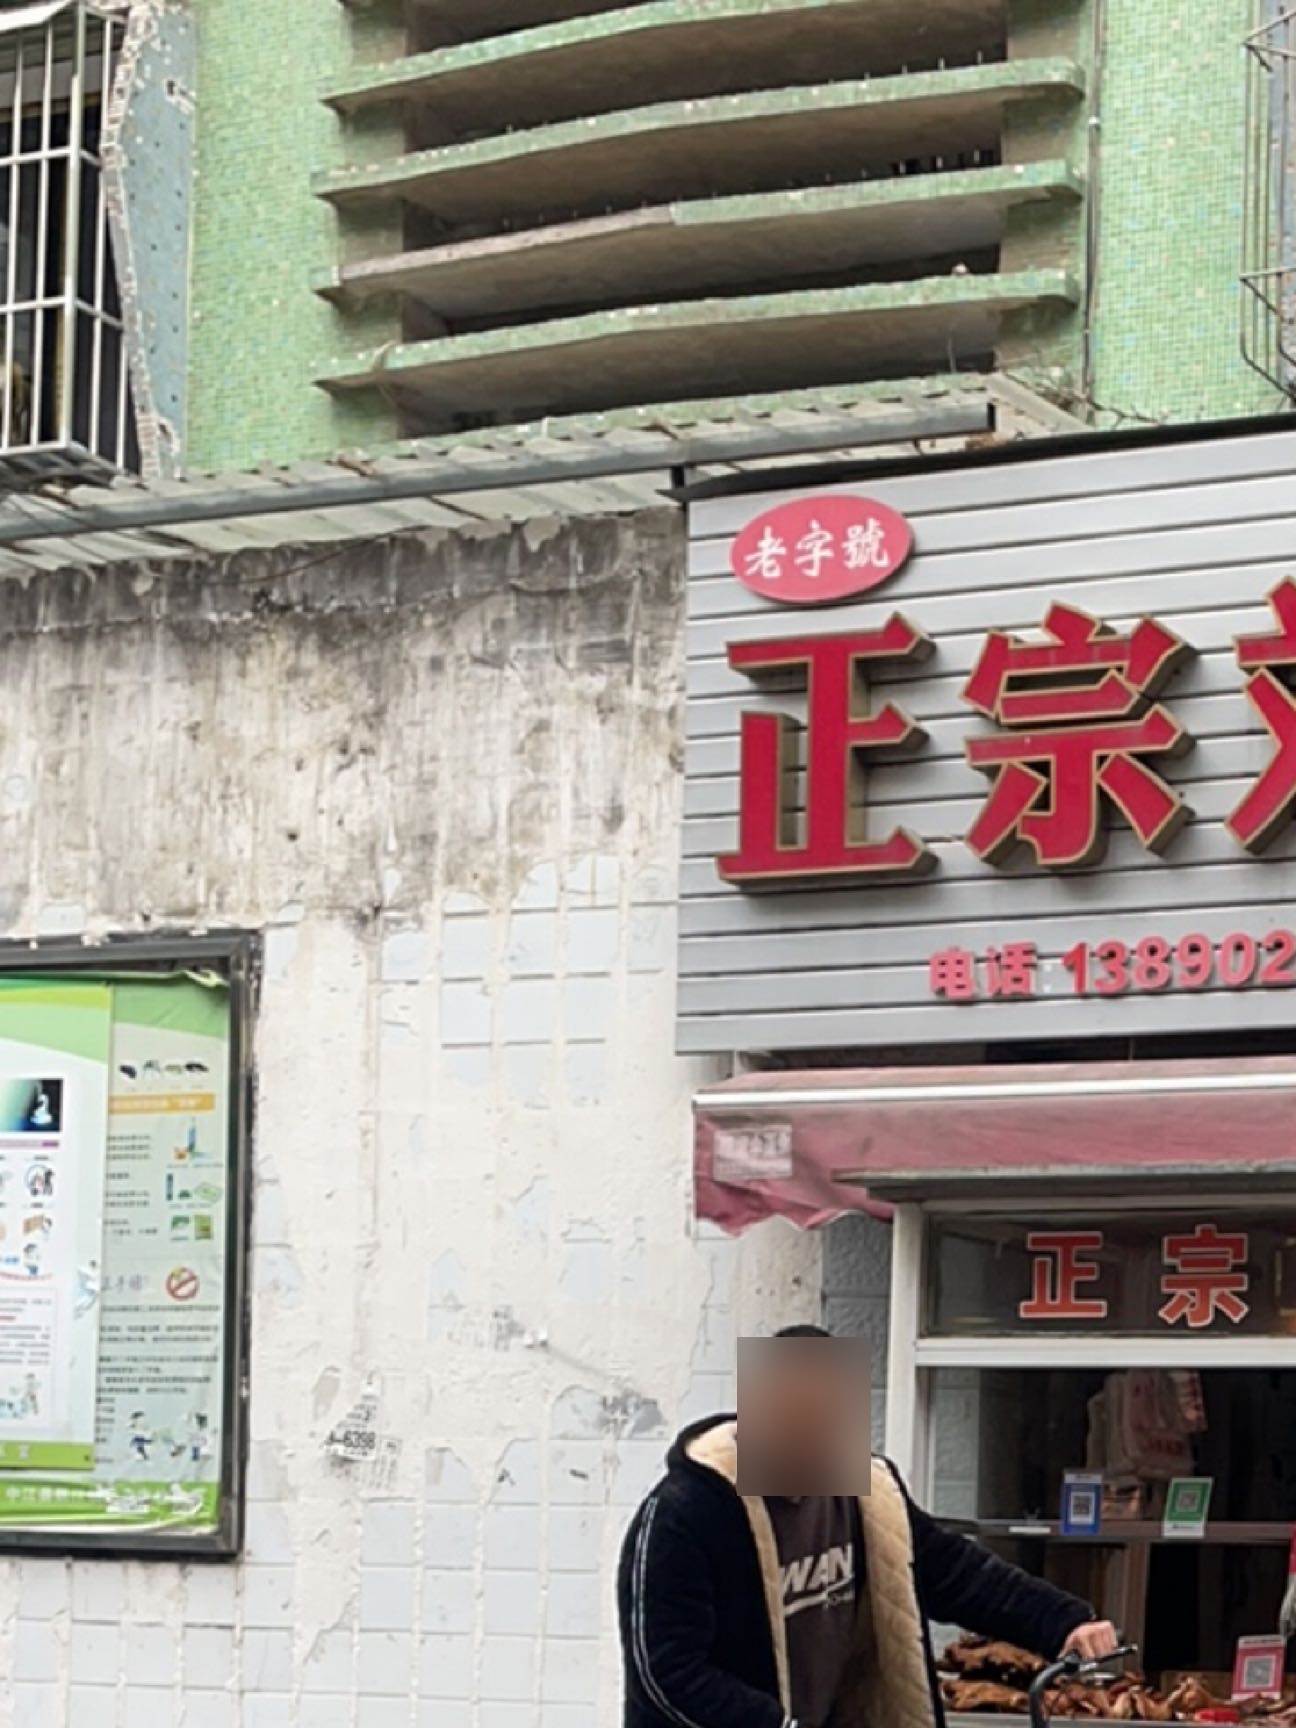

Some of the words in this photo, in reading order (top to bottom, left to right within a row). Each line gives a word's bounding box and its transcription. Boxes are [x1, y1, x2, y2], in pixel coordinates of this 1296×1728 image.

[742, 518, 892, 579] 老字號
[929, 940, 1037, 1000] 电话
